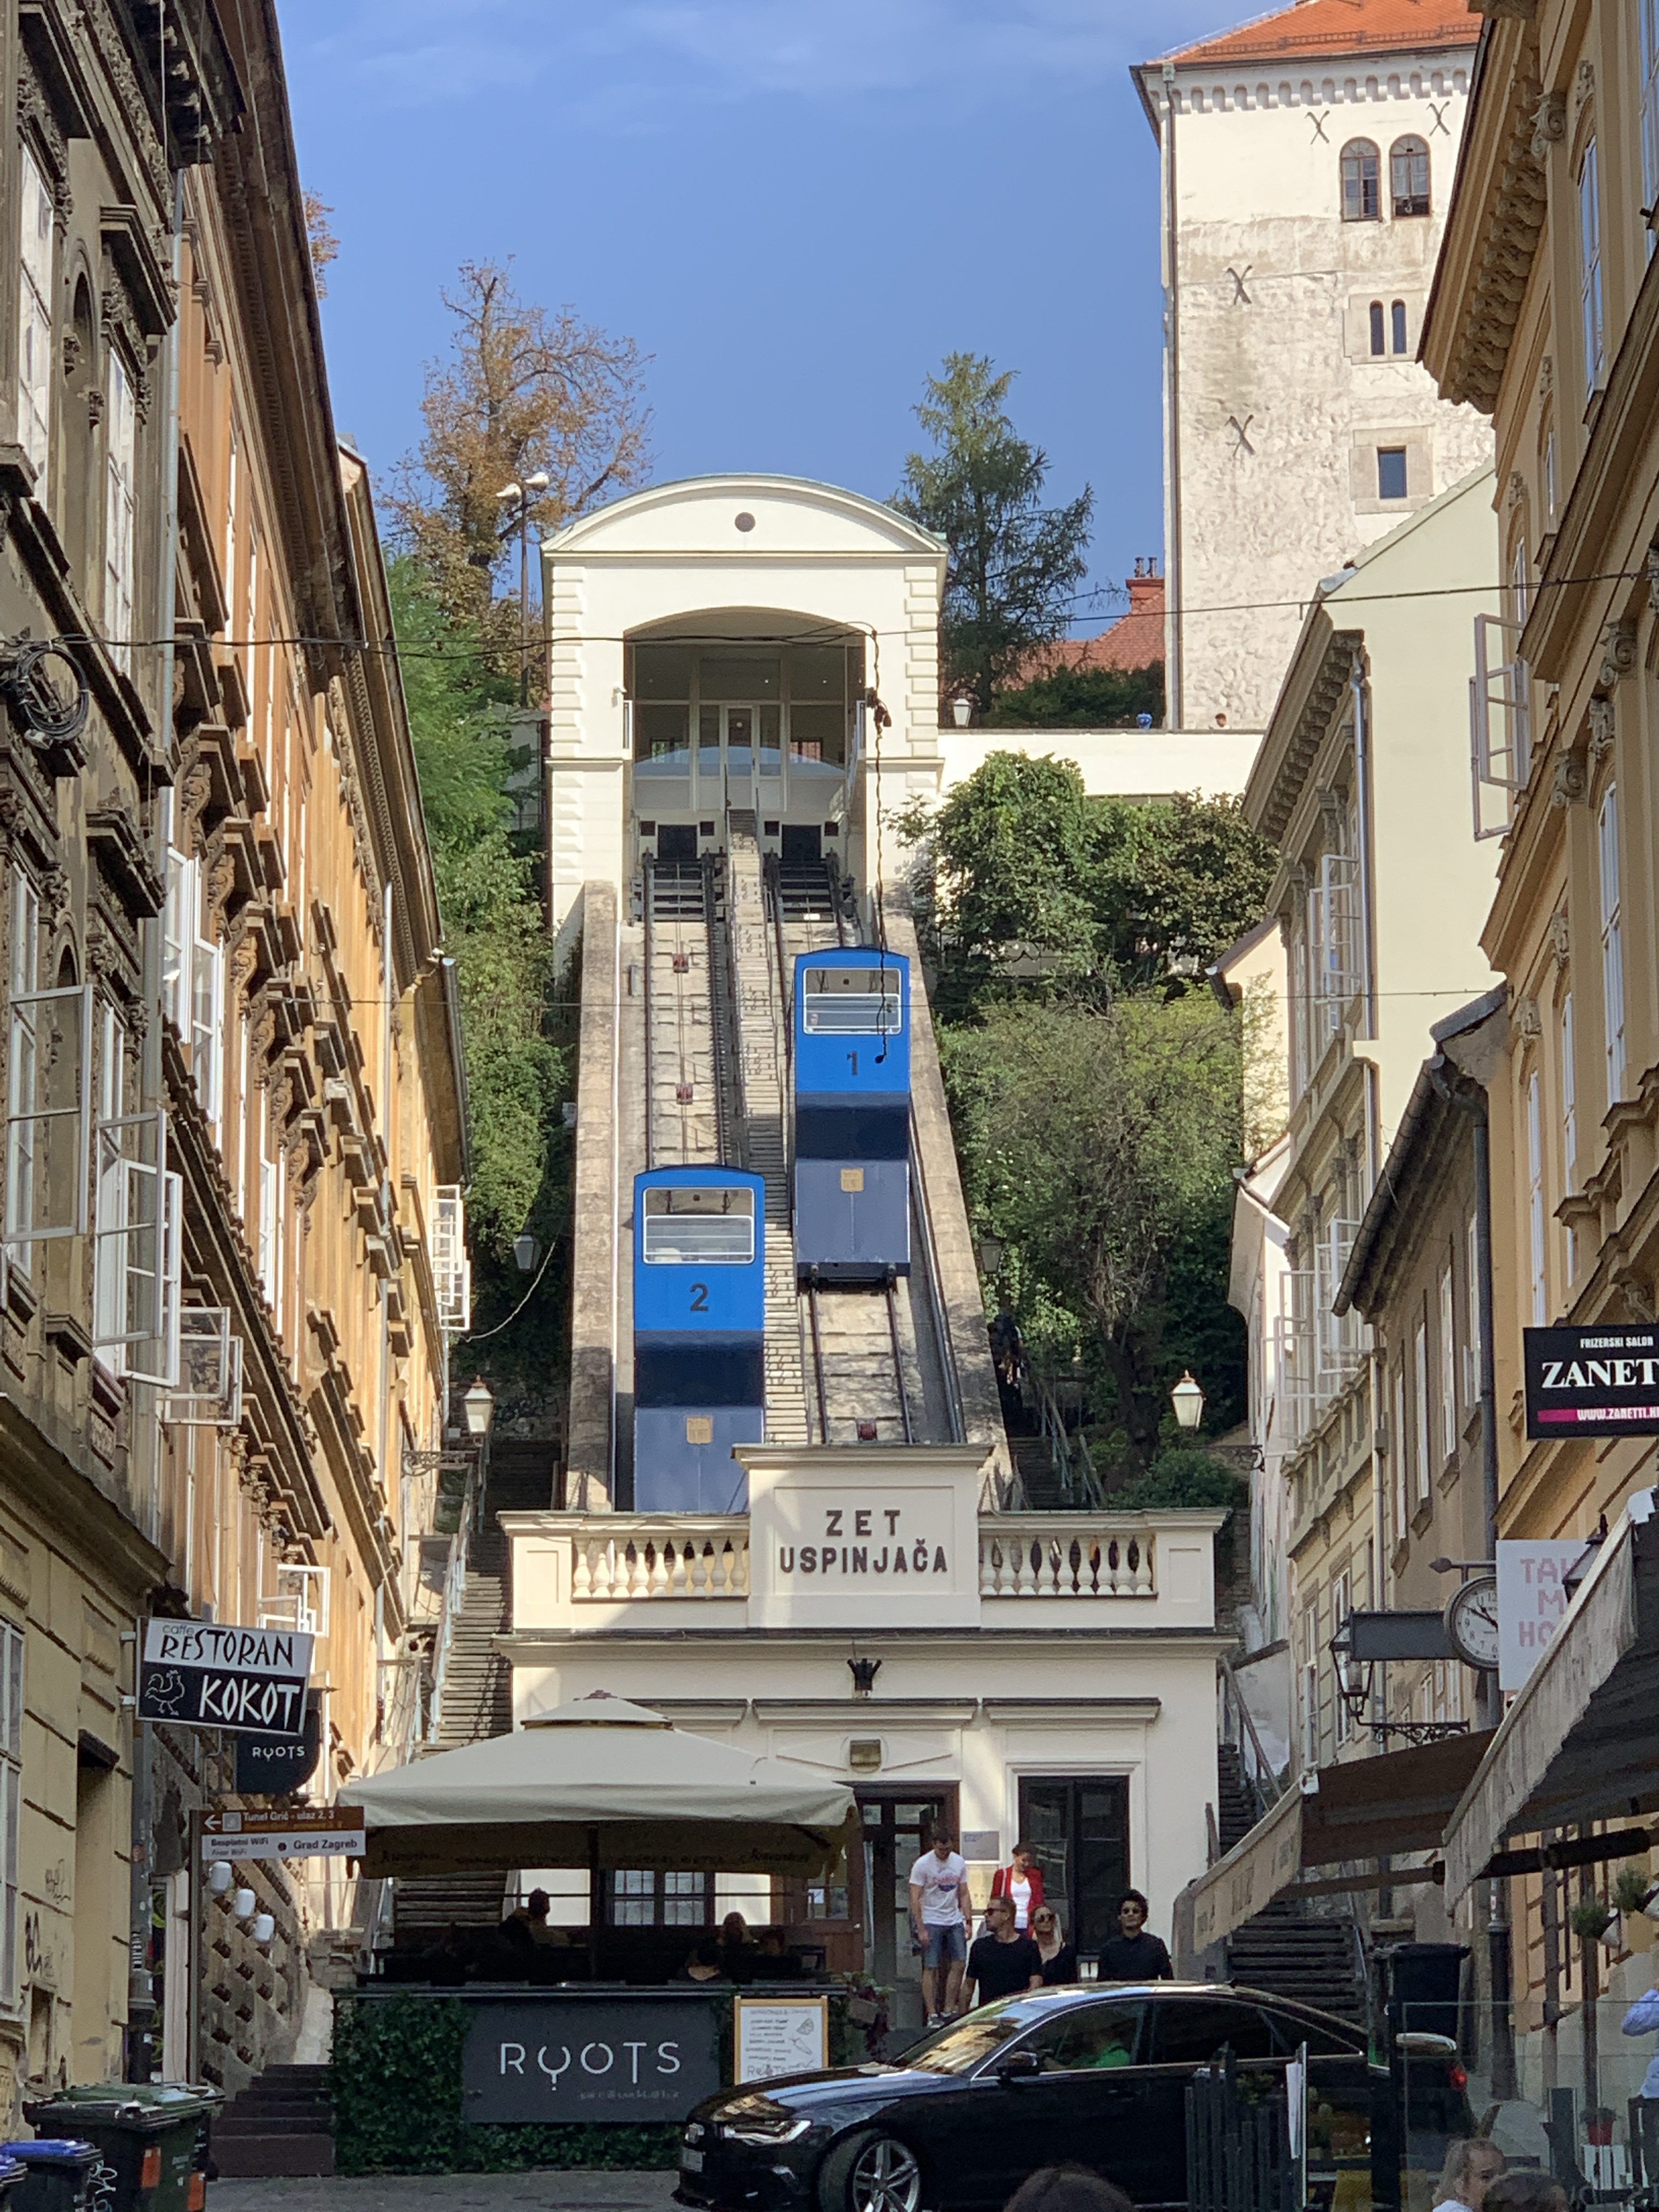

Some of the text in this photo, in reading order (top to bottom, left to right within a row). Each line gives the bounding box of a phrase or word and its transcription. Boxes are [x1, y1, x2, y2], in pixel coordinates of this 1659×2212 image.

[847, 1051, 857, 1076] 1
[690, 1282, 709, 1312] 2
[1579, 1336, 1654, 1348] FRIZERSKI SALON
[826, 1510, 900, 1536] ZET
[780, 1538, 947, 1573] USPINJAČA
[162, 1623, 194, 1635] caffe
[160, 1627, 293, 1668] RESTORAN
[199, 1674, 301, 1730] KOKOT
[252, 1746, 306, 1762] ROOTS
[294, 1838, 357, 1851] Grad Zagreb
[500, 2042, 680, 2091] ROOTS
